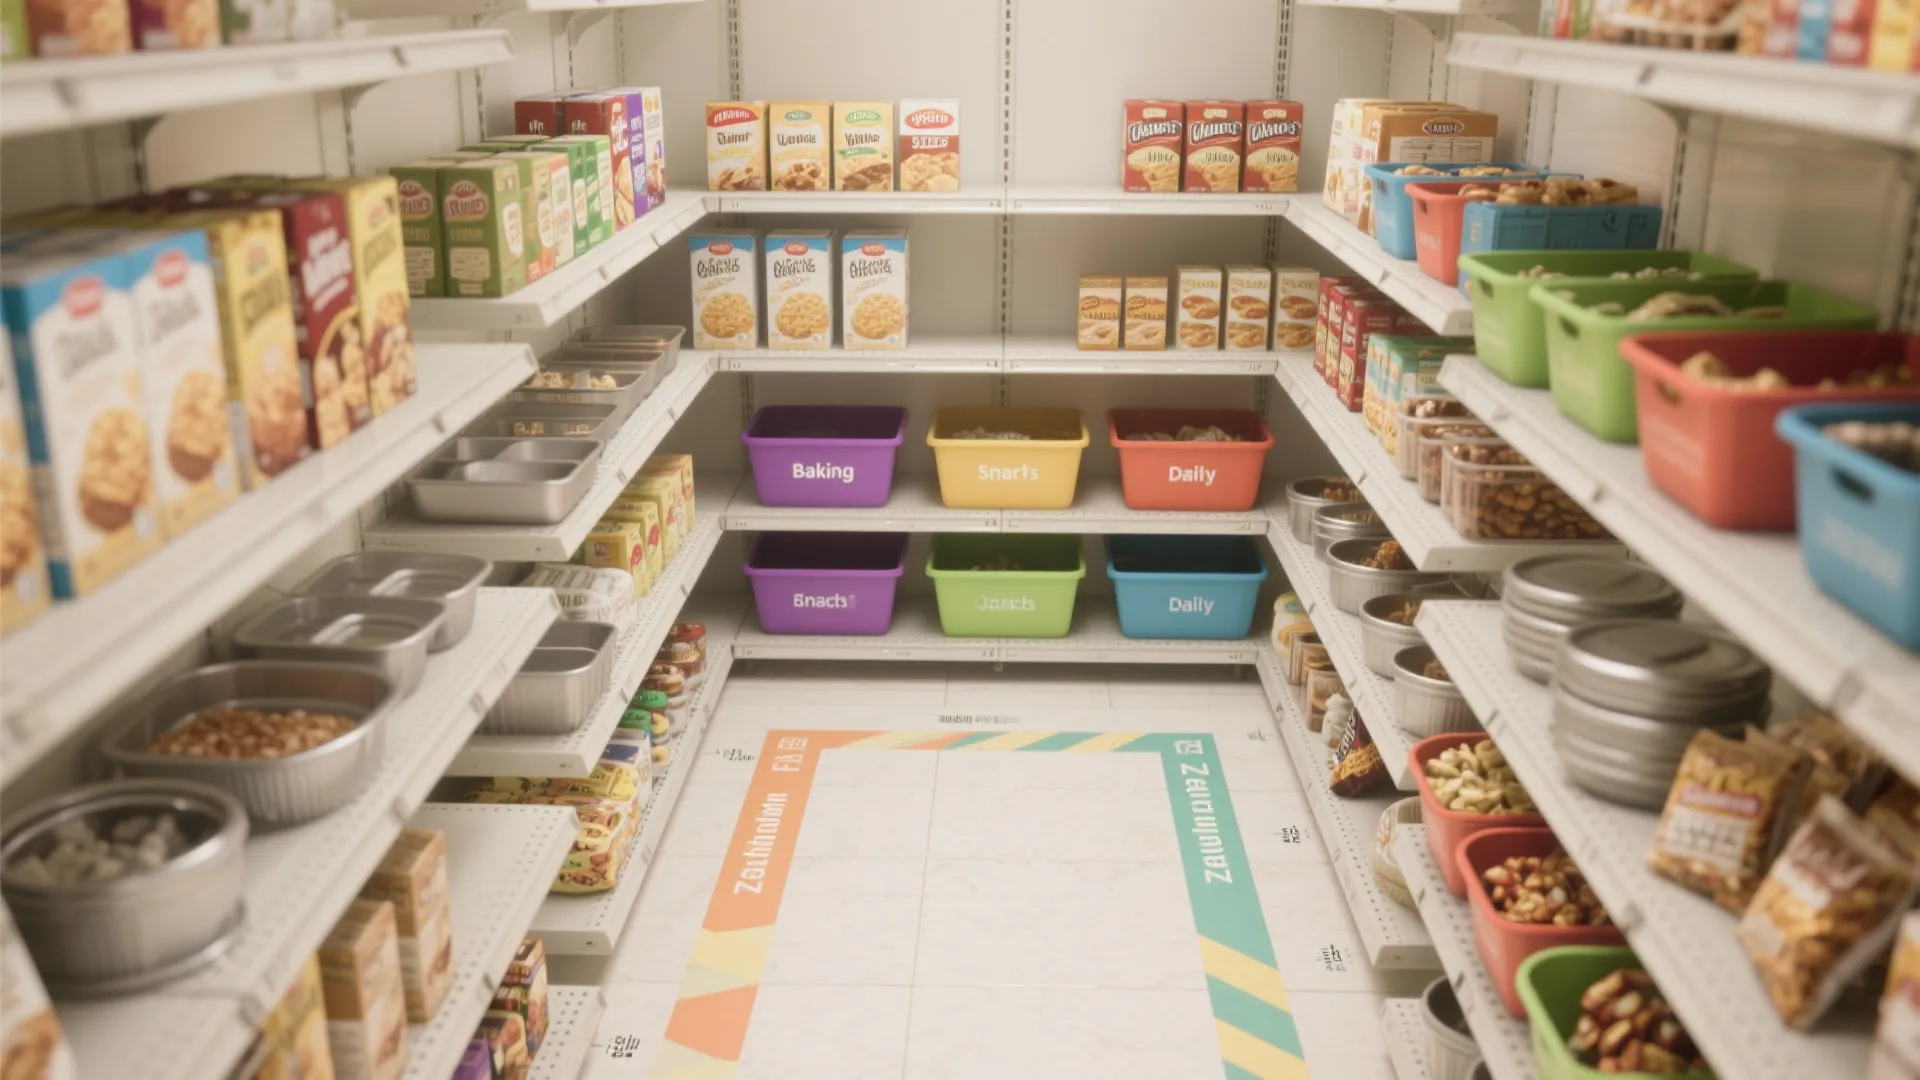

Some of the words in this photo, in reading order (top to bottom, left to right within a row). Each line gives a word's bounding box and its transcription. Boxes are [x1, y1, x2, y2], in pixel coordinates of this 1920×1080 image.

[792, 463, 855, 483] Baking
[1168, 464, 1217, 486] Daily
[1168, 596, 1215, 616] Daily
